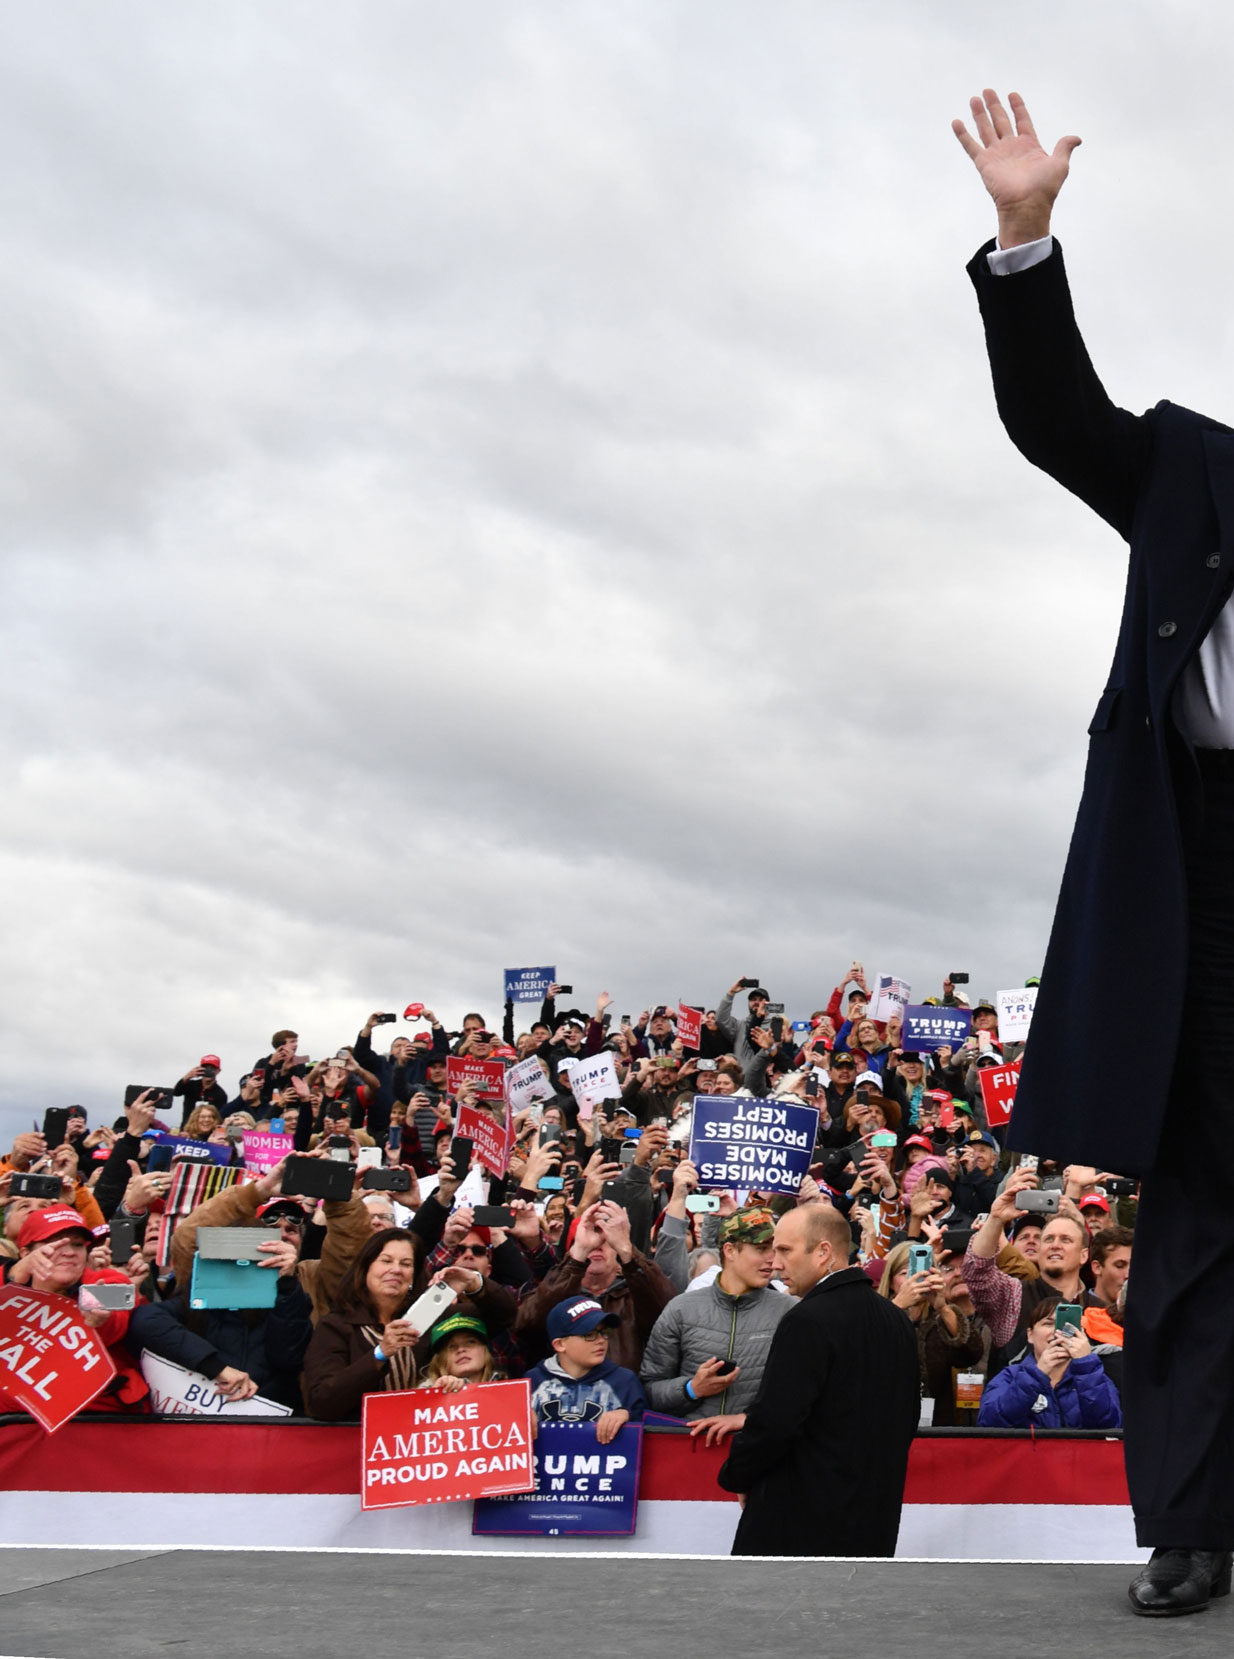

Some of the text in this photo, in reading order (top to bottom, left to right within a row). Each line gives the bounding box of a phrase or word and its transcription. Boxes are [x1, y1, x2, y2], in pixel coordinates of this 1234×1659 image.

[521, 971, 541, 979] KEEP
[519, 991, 543, 999] GREAT
[909, 1018, 967, 1030] TRUMP
[914, 1028, 961, 1036] PENCE
[449, 1070, 504, 1086] AMERICA
[464, 1065, 485, 1073] MAKE
[572, 1066, 609, 1088] TRUMP
[512, 1070, 543, 1091] TRUMP
[733, 1105, 787, 1121] KEPT
[243, 1134, 293, 1150] WOMEN
[457, 1123, 505, 1160] AMERICA
[704, 1121, 808, 1147] PROMISES
[175, 1143, 211, 1158] KEEP
[254, 1152, 270, 1161] FOR
[725, 1145, 787, 1167] MADE
[700, 1162, 803, 1188] PROMISES
[0, 1295, 101, 1372] FINISH
[16, 1325, 54, 1354] THE
[184, 1383, 229, 1413] BUY
[414, 1402, 479, 1426] MAKE
[367, 1421, 527, 1463] AMERICA
[367, 1451, 528, 1487] PROUD AGAIN
[533, 1454, 628, 1476] RUMP
[533, 1477, 613, 1492] ENCE
[490, 1494, 625, 1502] MAKE AMERICA GREAT AGAIN!
[548, 1528, 559, 1536] 45
